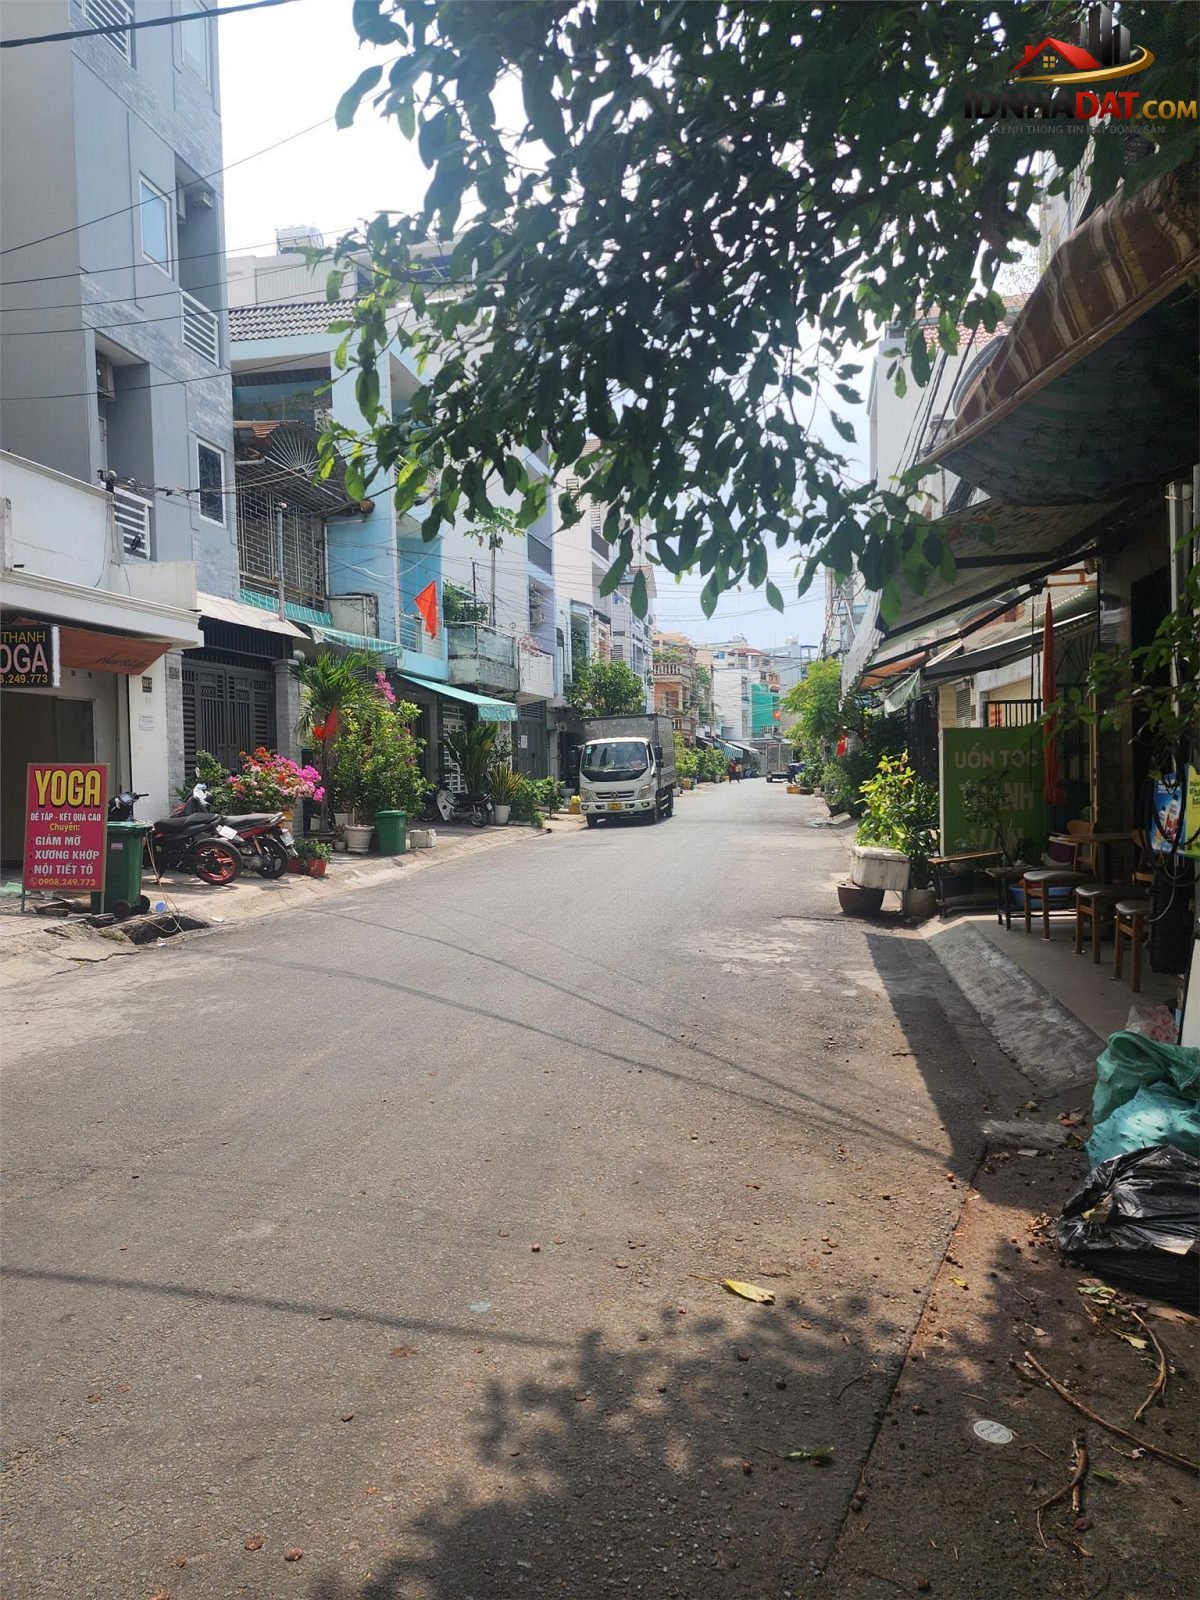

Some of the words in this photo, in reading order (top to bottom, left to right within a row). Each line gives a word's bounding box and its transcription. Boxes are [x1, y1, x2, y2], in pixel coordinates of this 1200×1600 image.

[1, 631, 46, 643] THANH
[955, 742, 995, 768] UỐN
[34, 769, 101, 807] YOGA
[73, 811, 87, 822] QUẢ
[87, 813, 101, 822] CAO
[35, 834, 61, 846] GIẢM
[64, 835, 81, 846] MỠ
[35, 850, 69, 860] XƯƠNG
[72, 850, 99, 860] KHỚP
[34, 863, 53, 876] NỘI
[55, 862, 77, 875] TIẾT
[80, 862, 94, 875] TỐ
[38, 878, 96, 886] 0908.249.773
